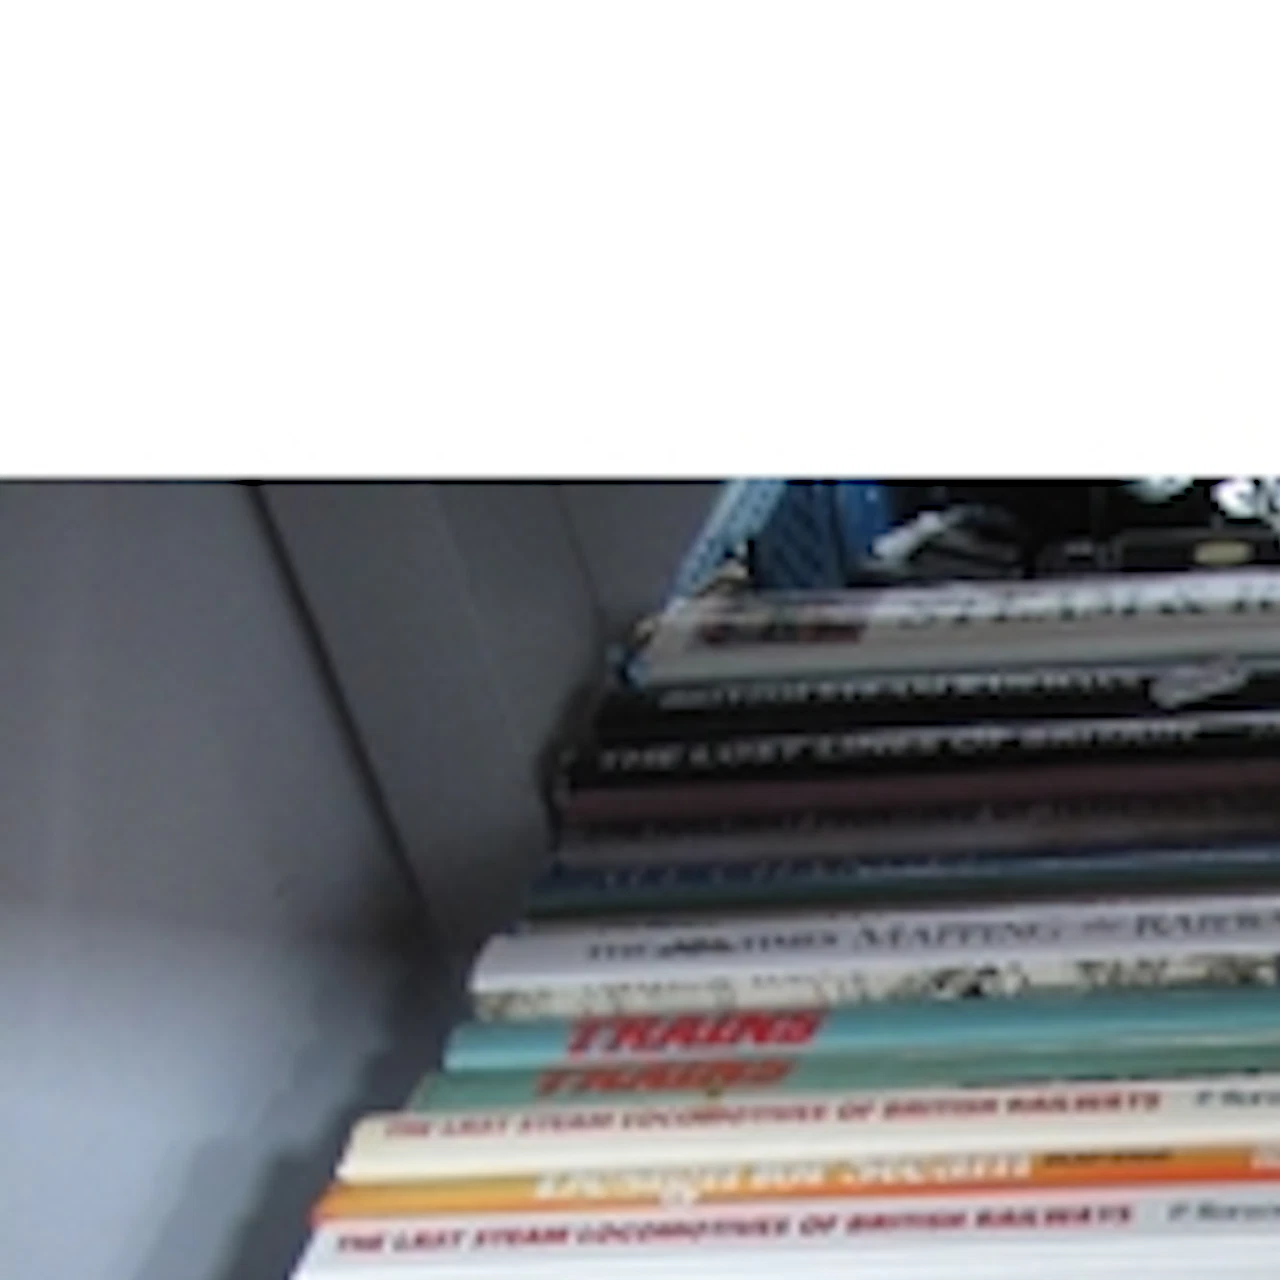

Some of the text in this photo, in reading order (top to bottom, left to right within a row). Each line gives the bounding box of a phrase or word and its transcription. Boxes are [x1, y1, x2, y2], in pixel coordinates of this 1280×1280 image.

[567, 1010, 829, 1056] TRAINS
[532, 1059, 799, 1096] TRAINS
[441, 1114, 510, 1138] LAST
[517, 1110, 614, 1136] STEAM
[622, 1102, 827, 1132] LOCOMOTIVES
[836, 1101, 876, 1122] OF
[882, 1096, 999, 1121] BRITISH
[1006, 1089, 1162, 1115] RAILWAYS
[337, 1233, 384, 1253] THE
[392, 1228, 466, 1253] LAST
[471, 1224, 570, 1250] STEAM
[576, 1215, 792, 1247] LOCOMOTIVES
[800, 1213, 838, 1236] OF
[846, 1207, 970, 1234] BRITISH
[976, 1202, 1134, 1230] RAILWAYS
